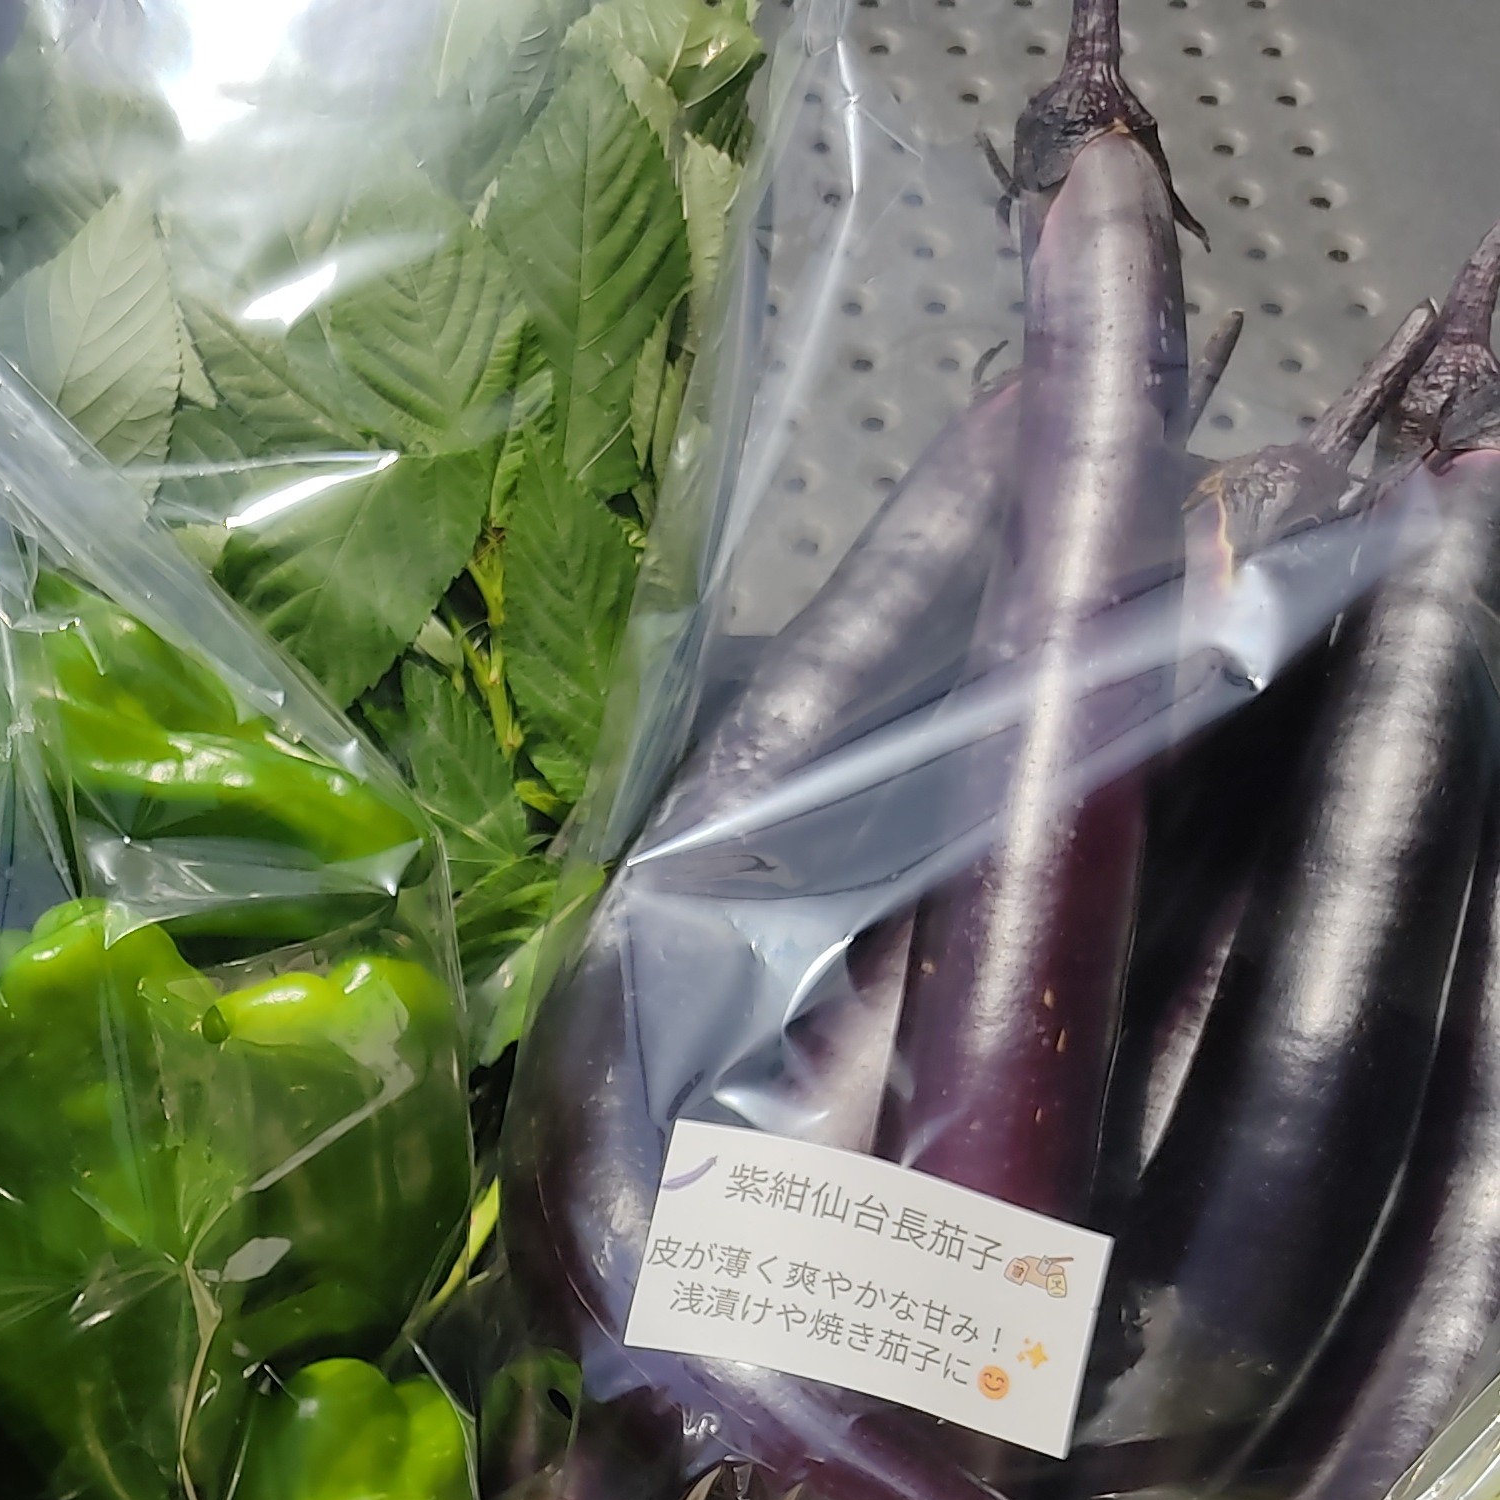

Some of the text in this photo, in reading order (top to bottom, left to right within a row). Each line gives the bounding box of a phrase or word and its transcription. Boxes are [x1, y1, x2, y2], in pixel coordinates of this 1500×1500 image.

[724, 1163, 1003, 1271] 紫紺仙台長茄子
[669, 1281, 972, 1386] 浅漬けや焼き茄子に
